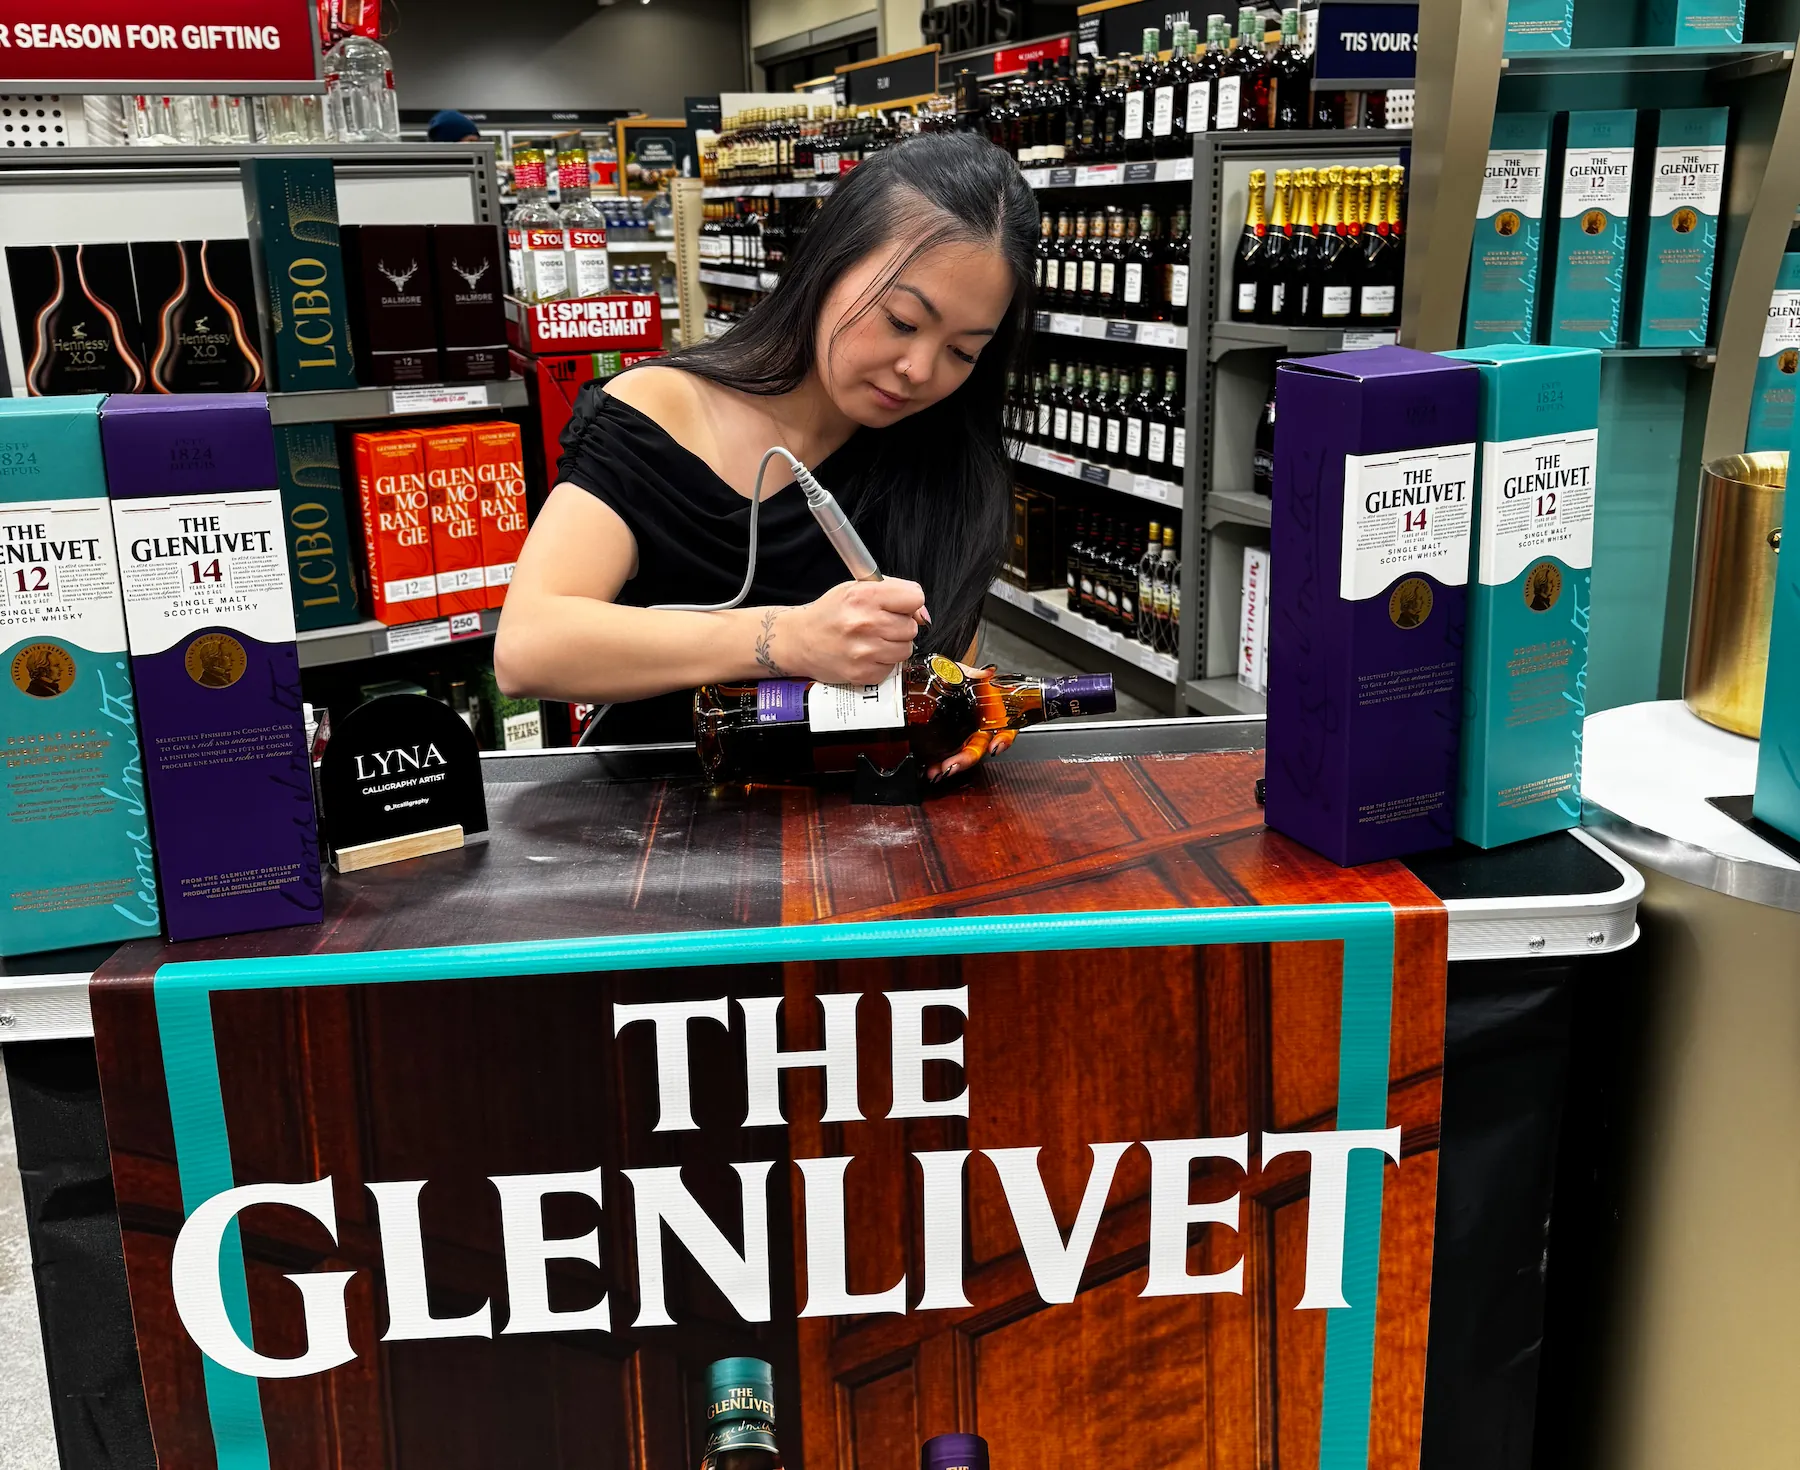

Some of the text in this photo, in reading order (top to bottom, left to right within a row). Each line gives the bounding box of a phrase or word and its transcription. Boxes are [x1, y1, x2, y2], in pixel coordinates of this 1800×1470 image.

[14, 23, 121, 49] SEASON
[126, 24, 178, 49] FOR
[181, 25, 280, 50] GIFTING
[1340, 32, 1368, 52] 'TIS
[1370, 31, 1411, 52] YOUR
[1504, 159, 1521, 167] THE
[1682, 155, 1699, 163] THE
[1505, 178, 1518, 189] 12
[1591, 176, 1604, 188] 12
[1682, 175, 1696, 186] 12
[382, 296, 422, 304] DALMORE
[455, 293, 493, 302] DALMORE
[288, 258, 336, 368] LCBO
[538, 318, 651, 339] CHANGEMENT
[53, 338, 110, 352] Hennessy
[177, 332, 232, 345] Hennessy
[478, 461, 523, 482] GLEN
[1535, 454, 1561, 471] THE
[376, 472, 425, 495] GLEN
[428, 465, 475, 489] GLEN
[1403, 469, 1432, 486] THE
[446, 484, 478, 503] MO
[496, 479, 526, 498] MO
[396, 490, 428, 511] MO
[481, 497, 517, 517] RAN
[1535, 492, 1557, 517] 12
[379, 512, 420, 531] RAN
[431, 503, 469, 523] RAN
[497, 512, 526, 532] GIE
[1403, 508, 1427, 533] 14
[3, 524, 46, 541] THE
[178, 516, 220, 533] THE
[448, 518, 478, 538] GIE
[1524, 526, 1567, 540] SINGLE MALT
[397, 526, 428, 547] GIE
[1518, 533, 1572, 549] SCOTCH WHISKY
[291, 503, 340, 608] LCBO
[1380, 549, 1448, 566] SCOTCH WHISKY
[1388, 543, 1441, 555] SINGLE MALT
[13, 566, 50, 592] 12
[188, 559, 223, 584] 14
[456, 573, 468, 586] 12
[405, 582, 418, 595] 12
[164, 603, 258, 618] SCOTCH WHISKY
[173, 595, 247, 608] SINGLE MALT
[1, 605, 73, 617] SINGLE MALT
[41, 613, 83, 622] WHISKY
[241, 726, 271, 735] COGNAC
[272, 724, 293, 732] CASKS
[260, 733, 290, 742] FLAVOUR
[507, 727, 539, 742] TEARS
[354, 742, 447, 780] LYNA
[362, 773, 446, 795] CALLIGRAPHY ARTIST
[181, 877, 203, 886] FROM
[220, 869, 259, 881] GLENLIVET
[260, 863, 301, 875] DISTILLERY
[183, 888, 211, 897] PRODUIT
[230, 881, 267, 892] DISTILLERIE
[267, 875, 300, 886] GLENLIVET
[614, 985, 969, 1131] THE
[170, 1125, 1402, 1379] GLENLIVET
[728, 1387, 753, 1398] THE
